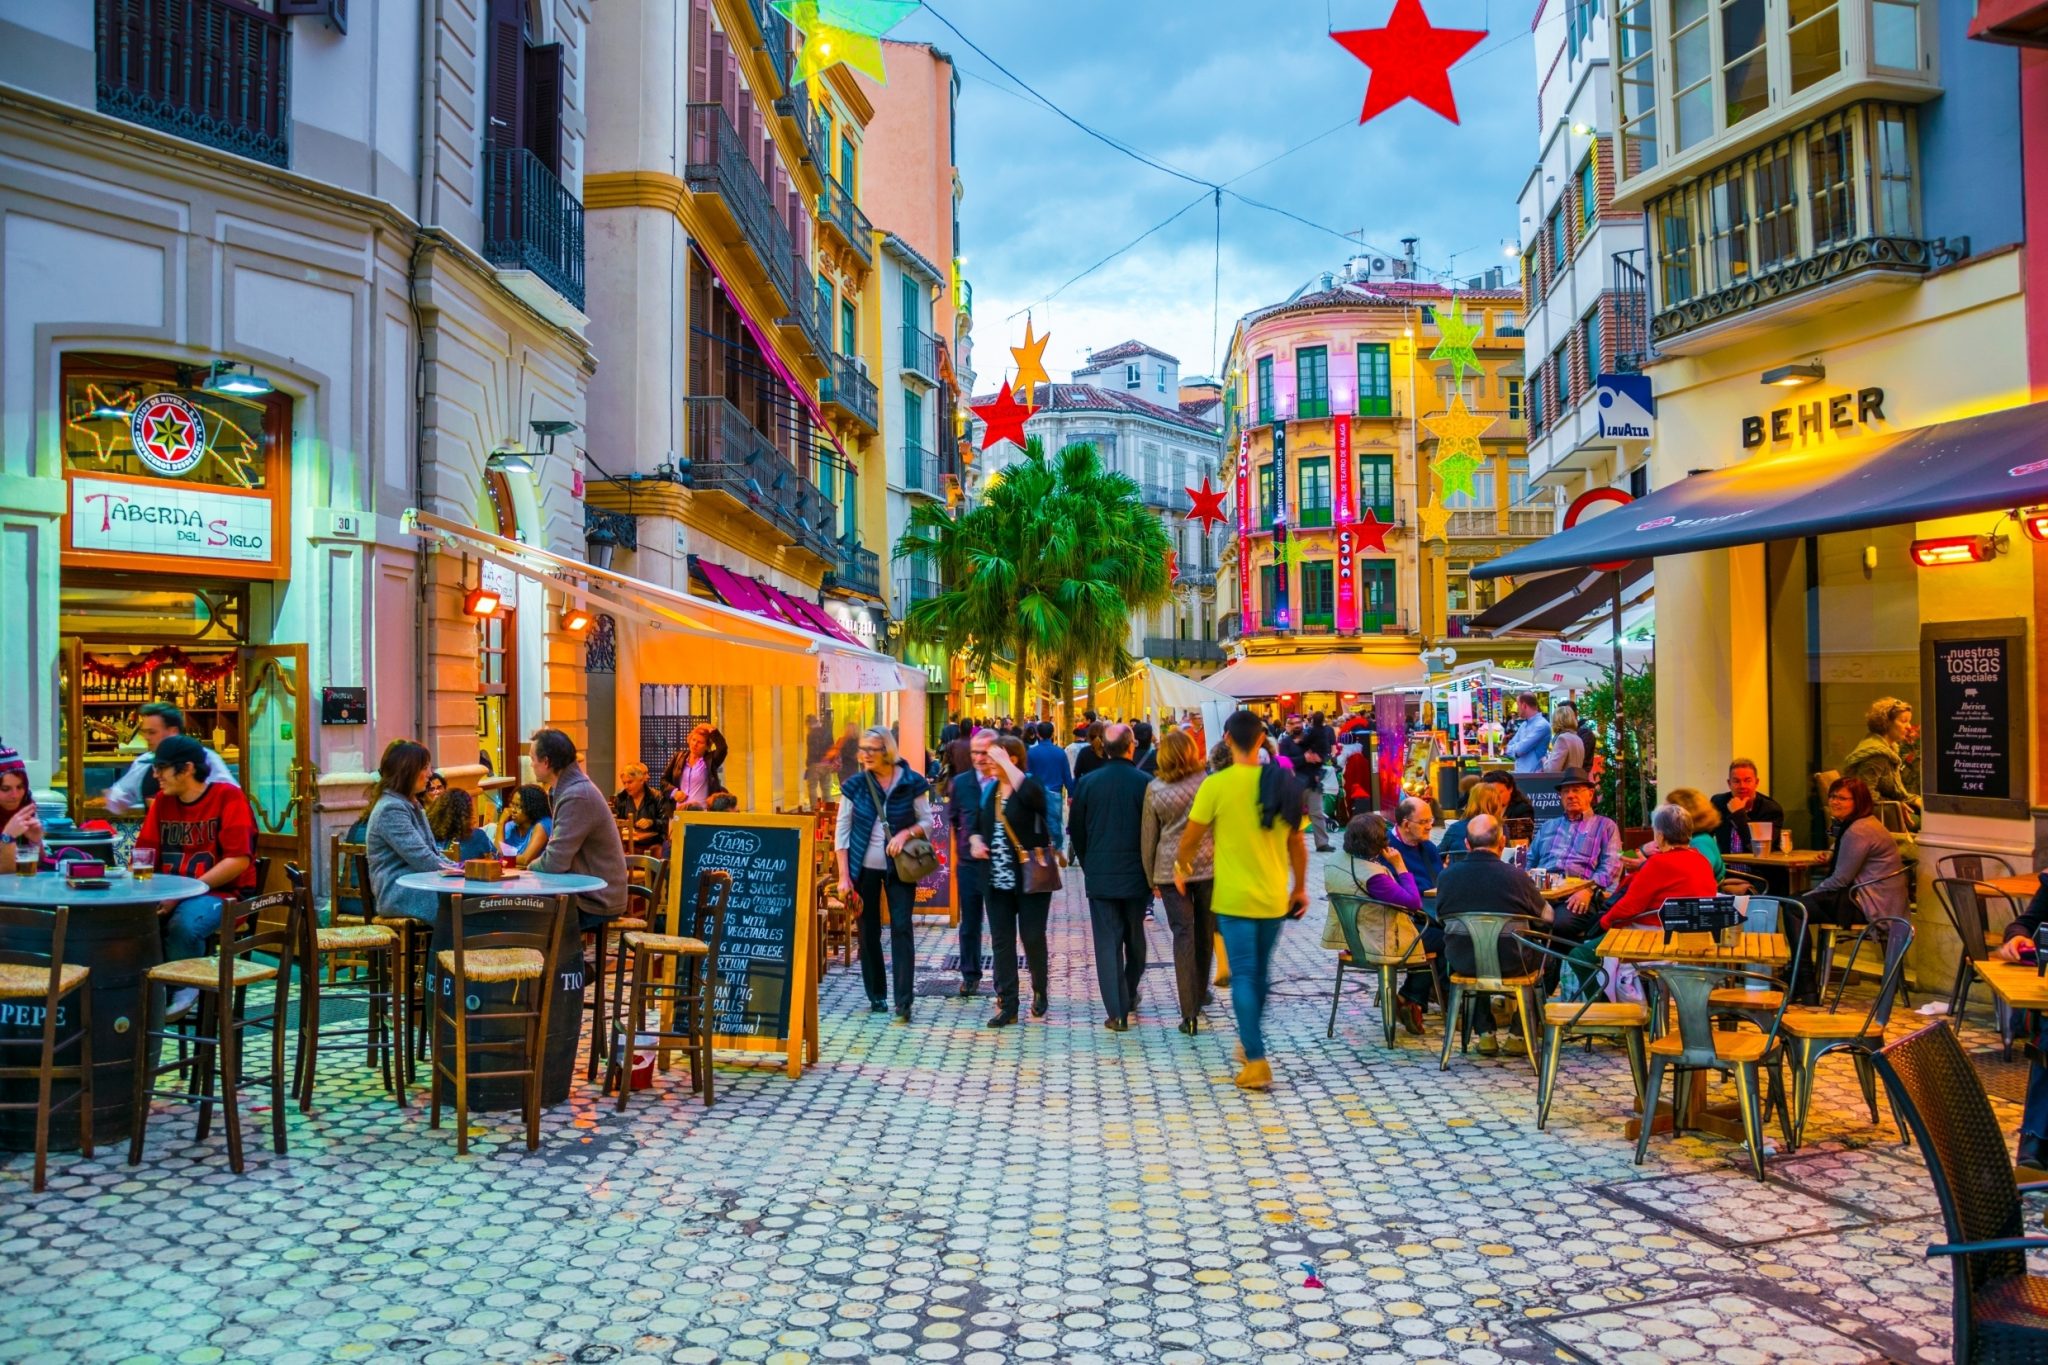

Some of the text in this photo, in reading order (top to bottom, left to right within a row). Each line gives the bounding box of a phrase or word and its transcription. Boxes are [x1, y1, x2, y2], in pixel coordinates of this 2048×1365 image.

[136, 403, 151, 424] HIJOS
[1742, 387, 1886, 449] BEHER
[1606, 423, 1650, 437] LAVAZZA
[135, 431, 172, 470] CERVECEROS
[171, 458, 193, 470] DESDE
[1340, 449, 1346, 458] DE
[84, 493, 204, 532] TABERNA
[338, 517, 350, 530] 30
[177, 520, 263, 549] DEL SIGLO
[1561, 644, 1593, 654] Mahou
[1947, 656, 2000, 674] tostas
[1950, 672, 1998, 684] especiales
[1954, 742, 1970, 750] Don
[1953, 759, 1993, 769] Primavera
[718, 834, 754, 852] TAPAS
[698, 853, 788, 872] RUSSIAN SALAD
[747, 870, 775, 882] WITH
[749, 882, 787, 895] SAUCE
[478, 897, 545, 909] Estrella Galicia
[754, 905, 782, 917] CREAM
[742, 915, 767, 927] WITH
[727, 926, 784, 941] VEGETABLES
[731, 943, 751, 954] OLD
[751, 944, 784, 958] CHEESE
[725, 972, 748, 987] TAIL
[734, 987, 754, 1001] PIG
[0, 1003, 66, 1026] PEPE
